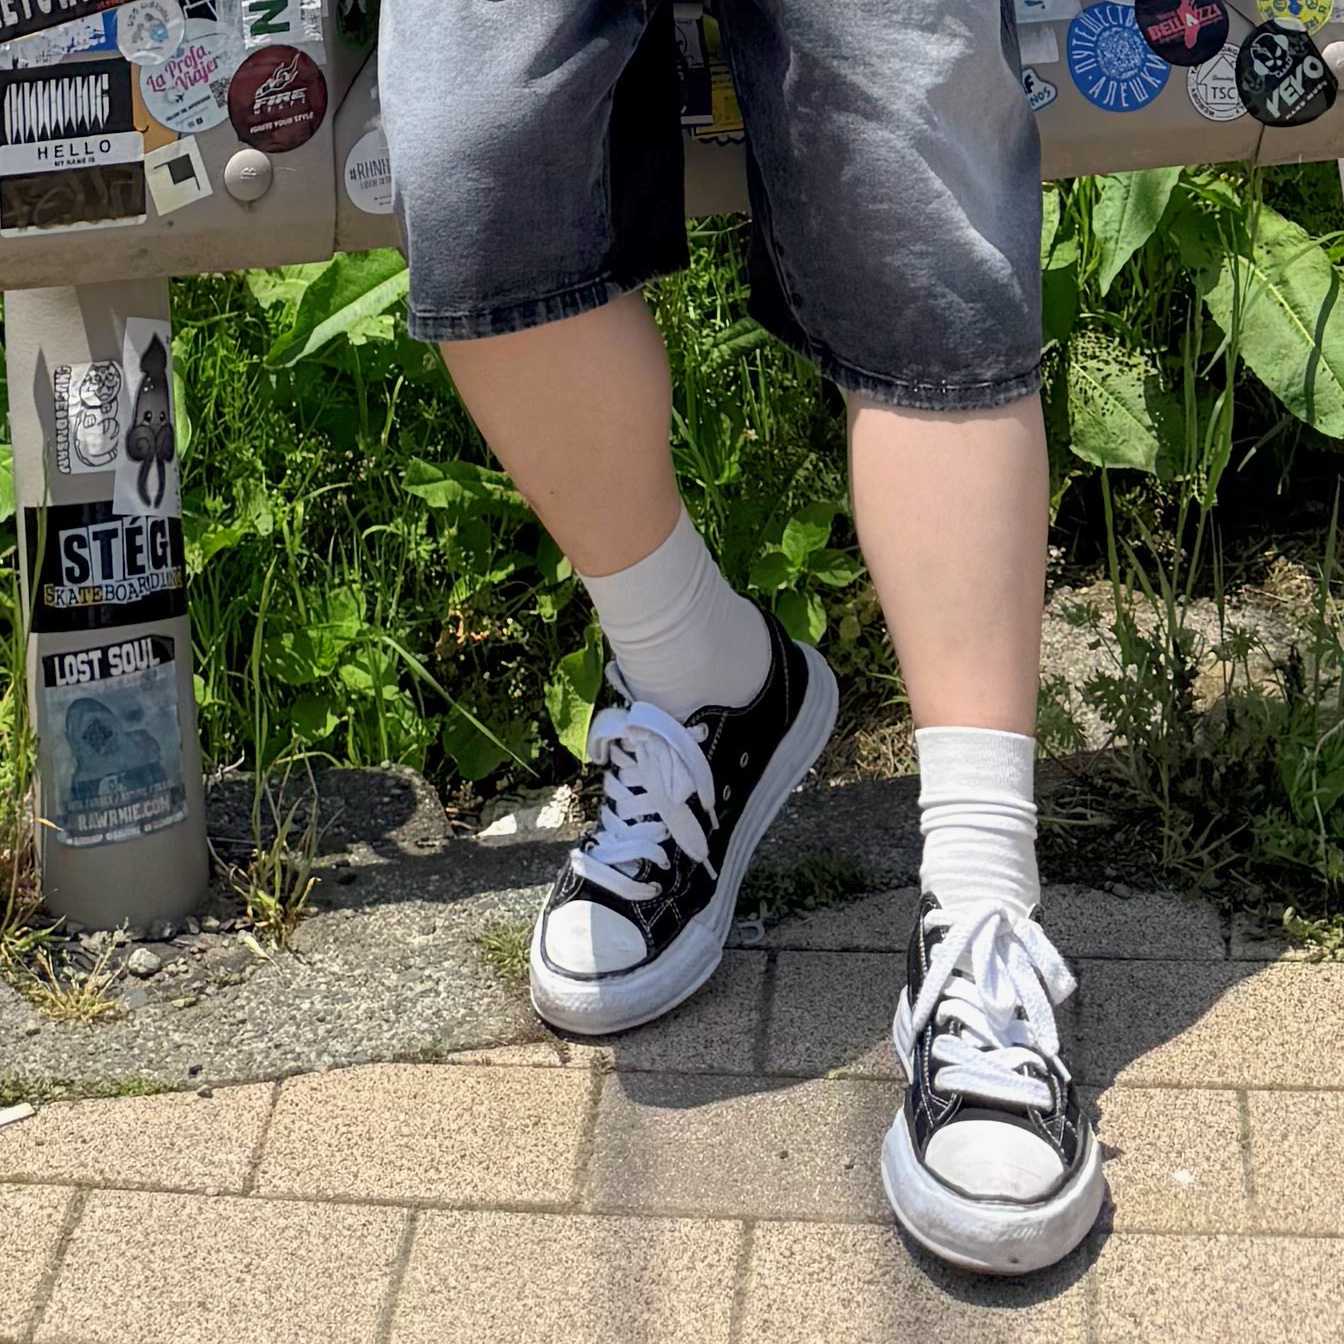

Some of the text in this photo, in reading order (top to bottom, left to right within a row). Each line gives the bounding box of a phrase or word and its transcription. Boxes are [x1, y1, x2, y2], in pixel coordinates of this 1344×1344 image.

[1072, 4, 1138, 75] ПУТЕШЕСТВ
[146, 73, 168, 93] La
[175, 54, 221, 92] Viajer
[1265, 55, 1325, 119] YEYO
[1211, 87, 1237, 100] TSC
[37, 139, 112, 160] HELLO
[54, 637, 161, 686] LOST SOUL
